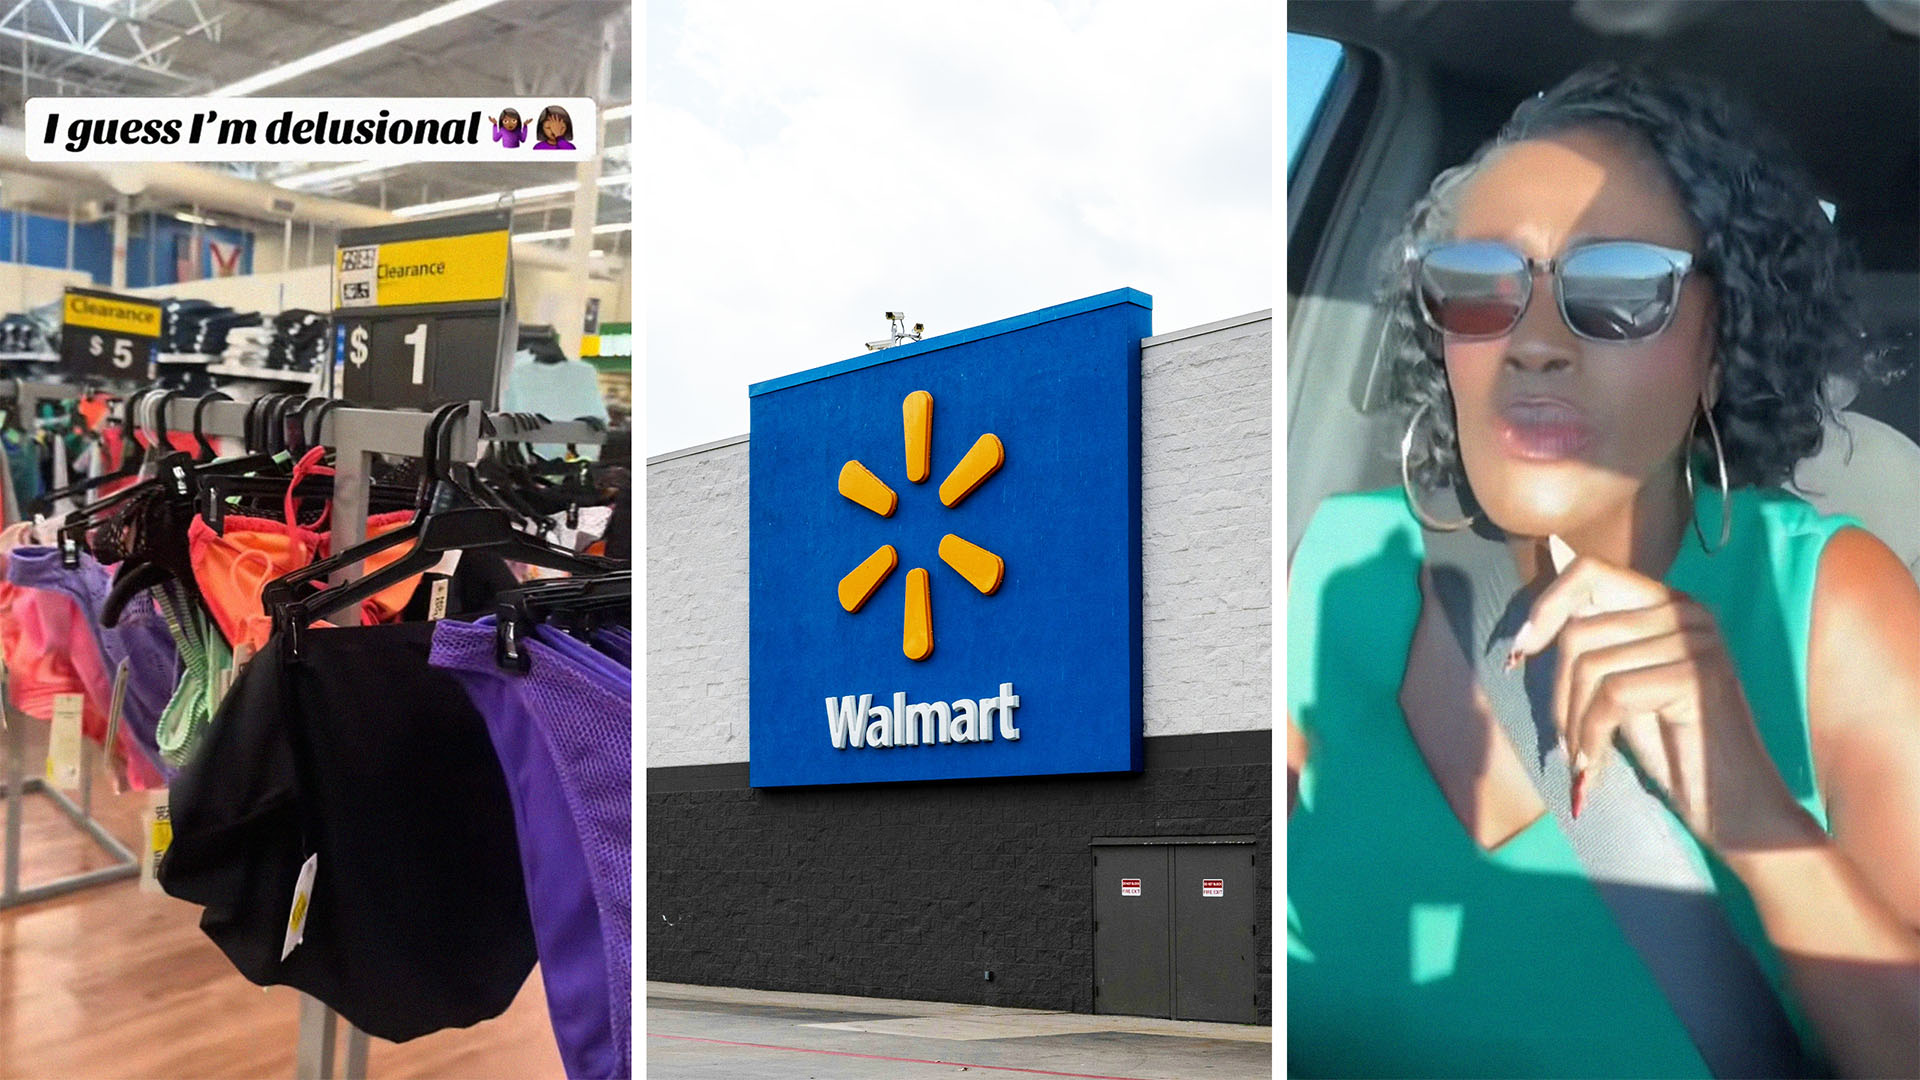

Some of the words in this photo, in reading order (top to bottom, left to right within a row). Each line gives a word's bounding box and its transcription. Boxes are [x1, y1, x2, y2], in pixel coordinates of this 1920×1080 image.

[376, 260, 446, 280] Clearance
[70, 298, 155, 323] Clearance
[112, 338, 133, 369] 5
[349, 324, 369, 369] $
[403, 323, 428, 385] 1
[825, 682, 1020, 750] Walmart
